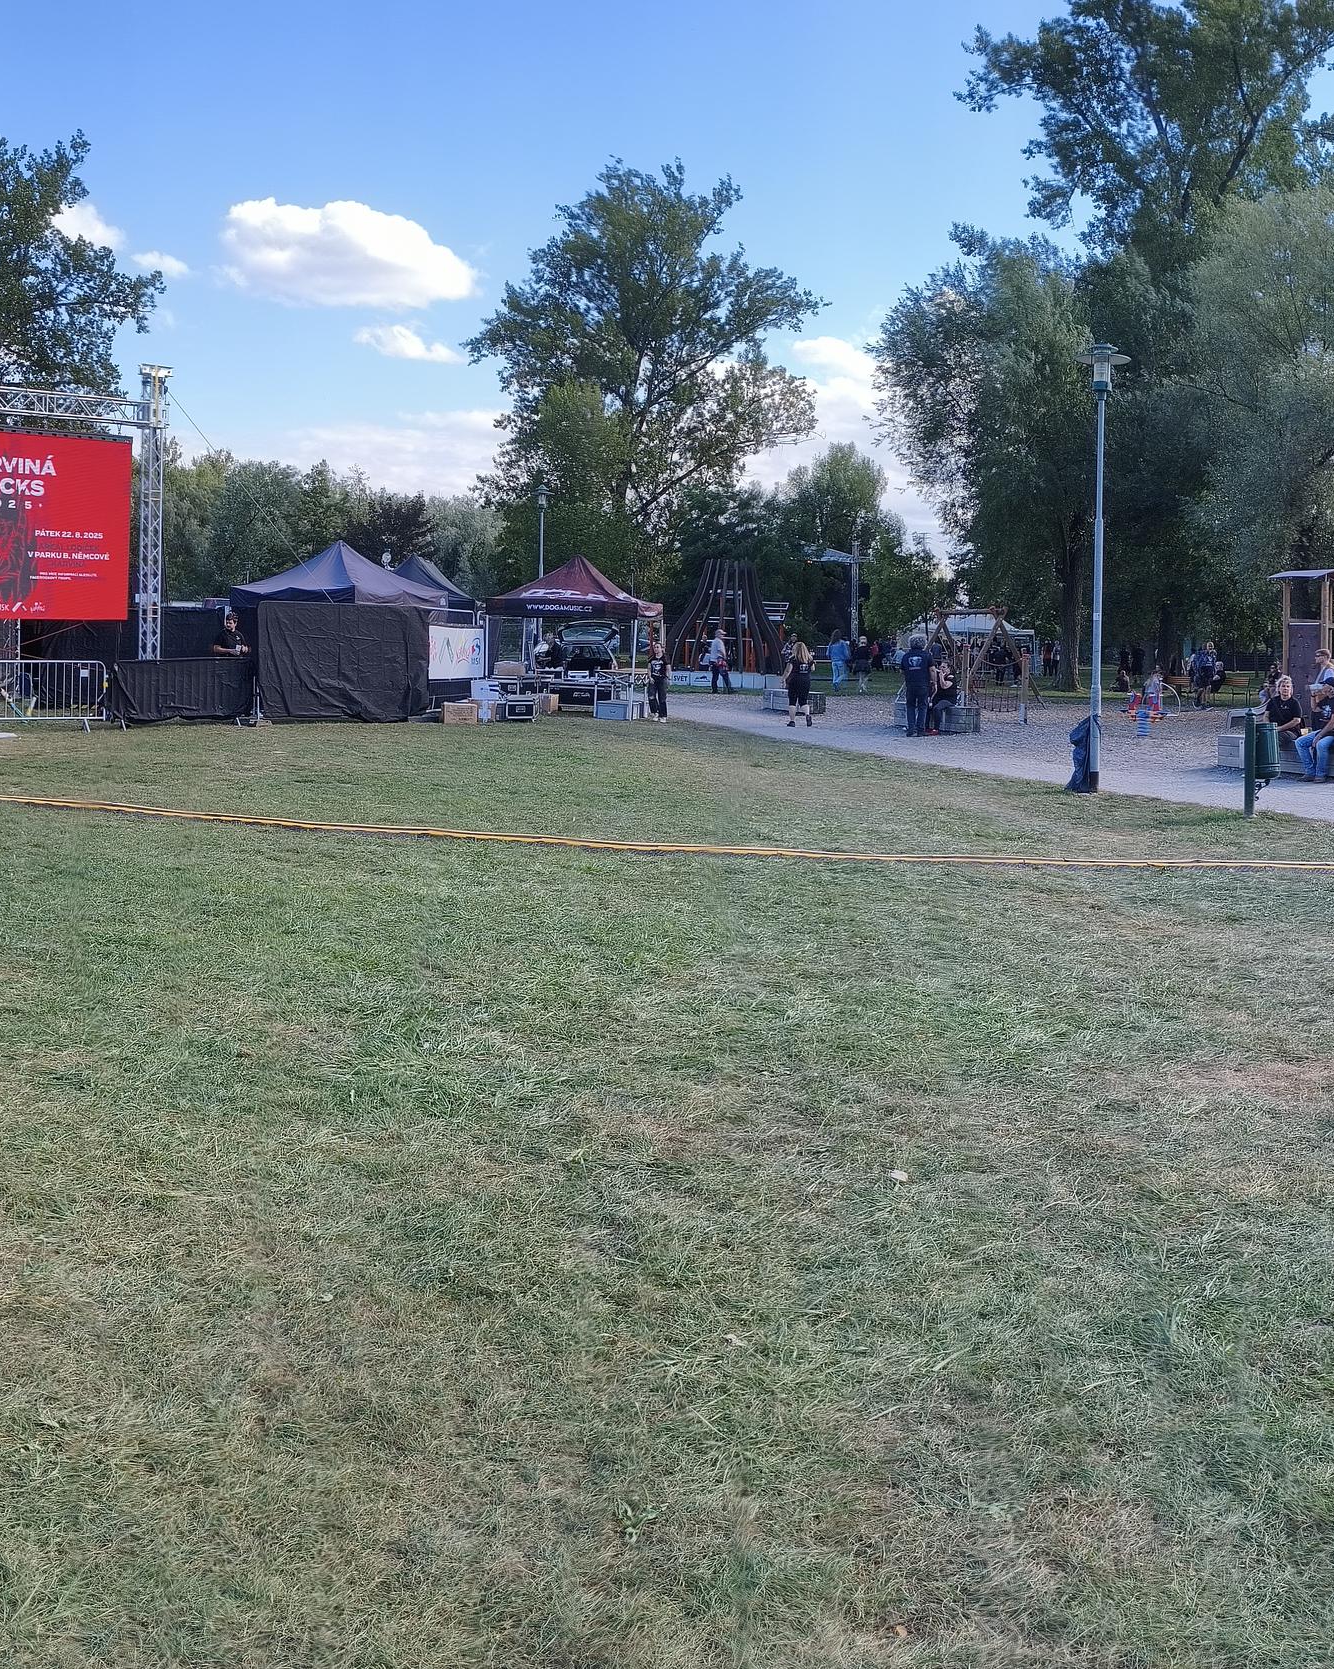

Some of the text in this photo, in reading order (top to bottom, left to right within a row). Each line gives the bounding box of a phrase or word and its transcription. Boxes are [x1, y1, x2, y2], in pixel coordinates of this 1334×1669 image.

[34, 529, 61, 537] PÁTEK
[35, 551, 62, 559] PARKU
[72, 551, 110, 560] NĚMCOVÉ
[526, 604, 592, 612] WWW.DOGAMUSIC.CZ
